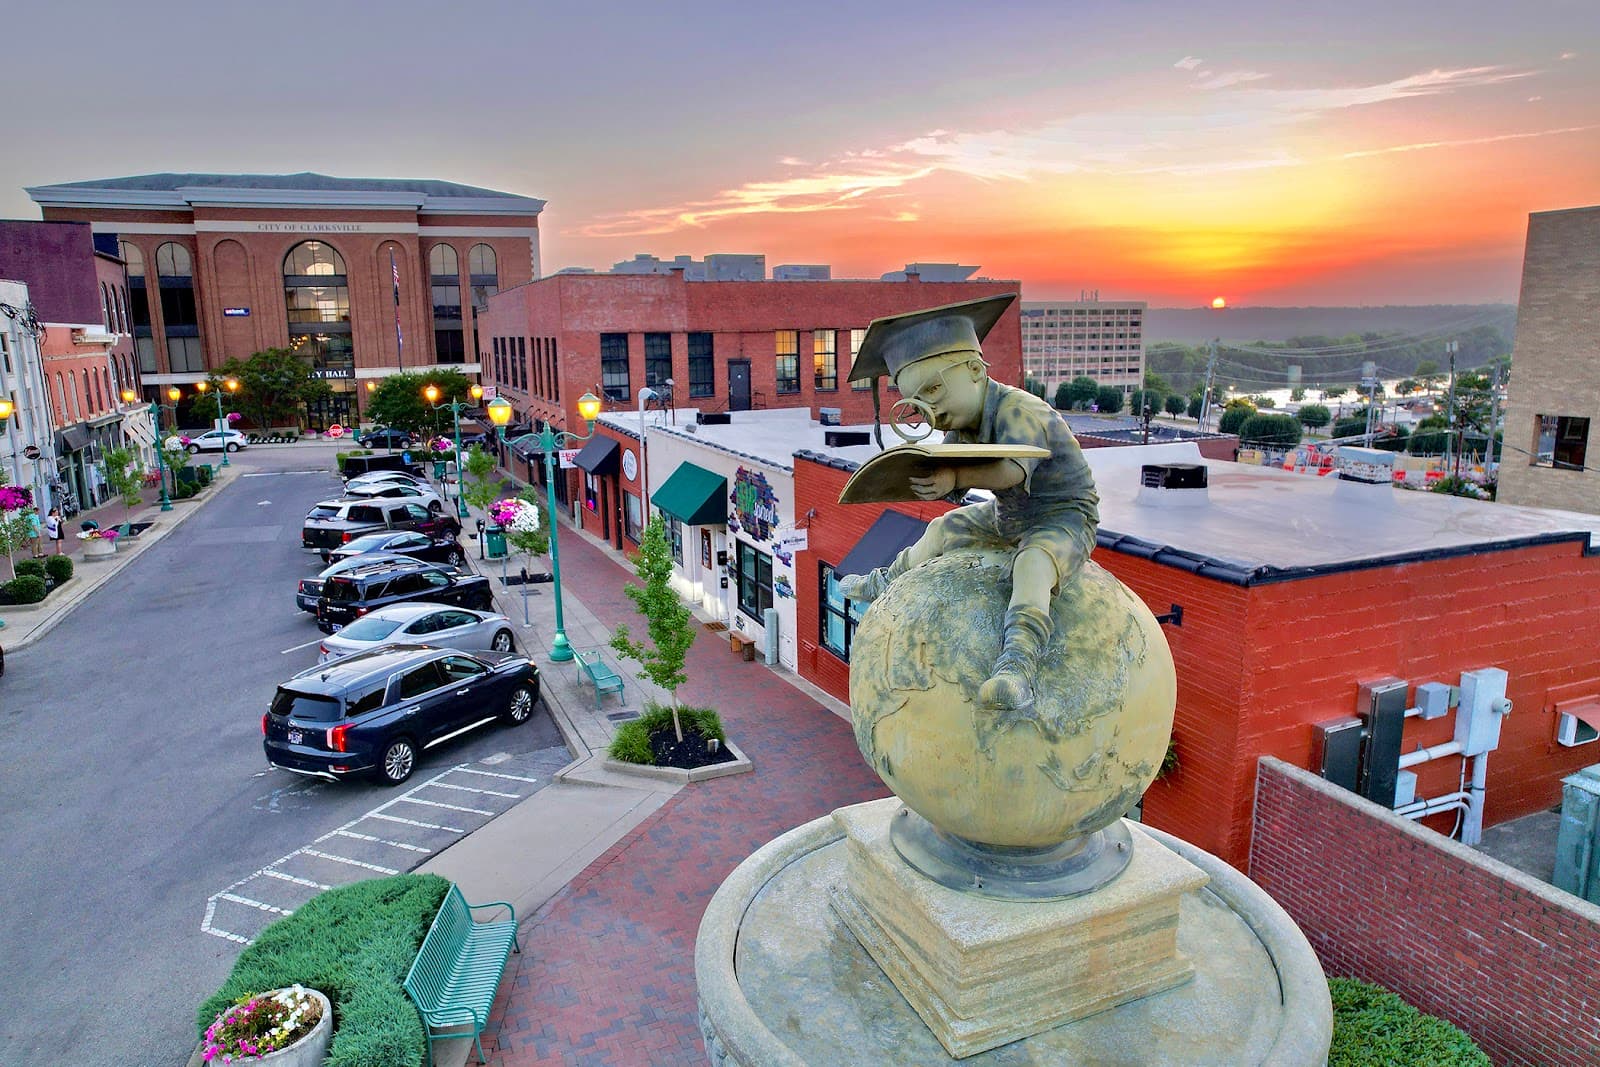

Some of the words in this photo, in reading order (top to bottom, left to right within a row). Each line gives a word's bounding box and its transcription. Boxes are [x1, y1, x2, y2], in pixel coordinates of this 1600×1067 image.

[257, 223, 281, 231] CITY
[284, 223, 295, 231] OF
[300, 223, 361, 232] CLARKSVILLE
[325, 370, 349, 378] HALL
